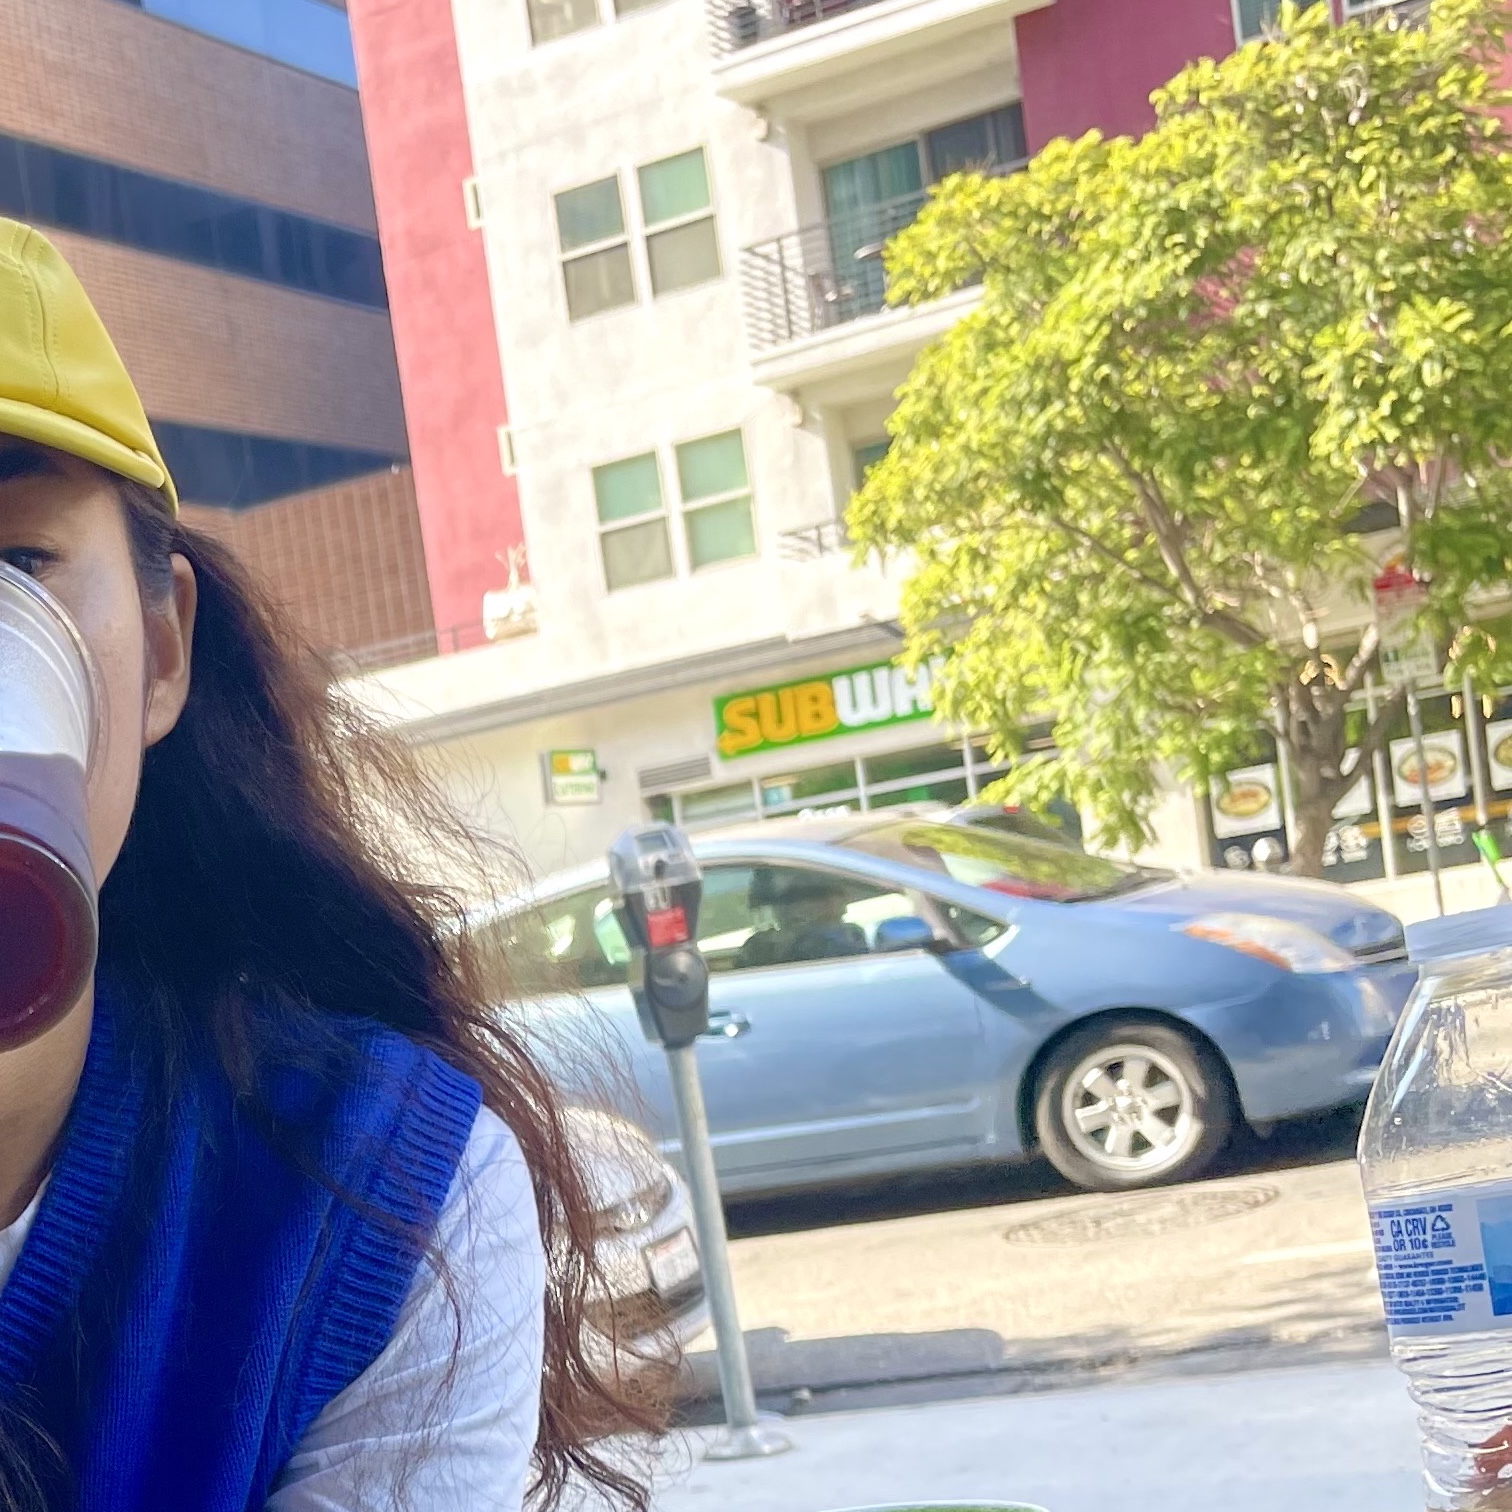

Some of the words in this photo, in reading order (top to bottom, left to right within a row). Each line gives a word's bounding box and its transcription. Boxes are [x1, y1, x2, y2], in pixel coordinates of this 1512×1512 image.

[718, 655, 946, 756] SUBWA
[1390, 1219, 1403, 1239] CA
[1405, 1217, 1427, 1238] CRV
[1393, 1238, 1406, 1251] OR
